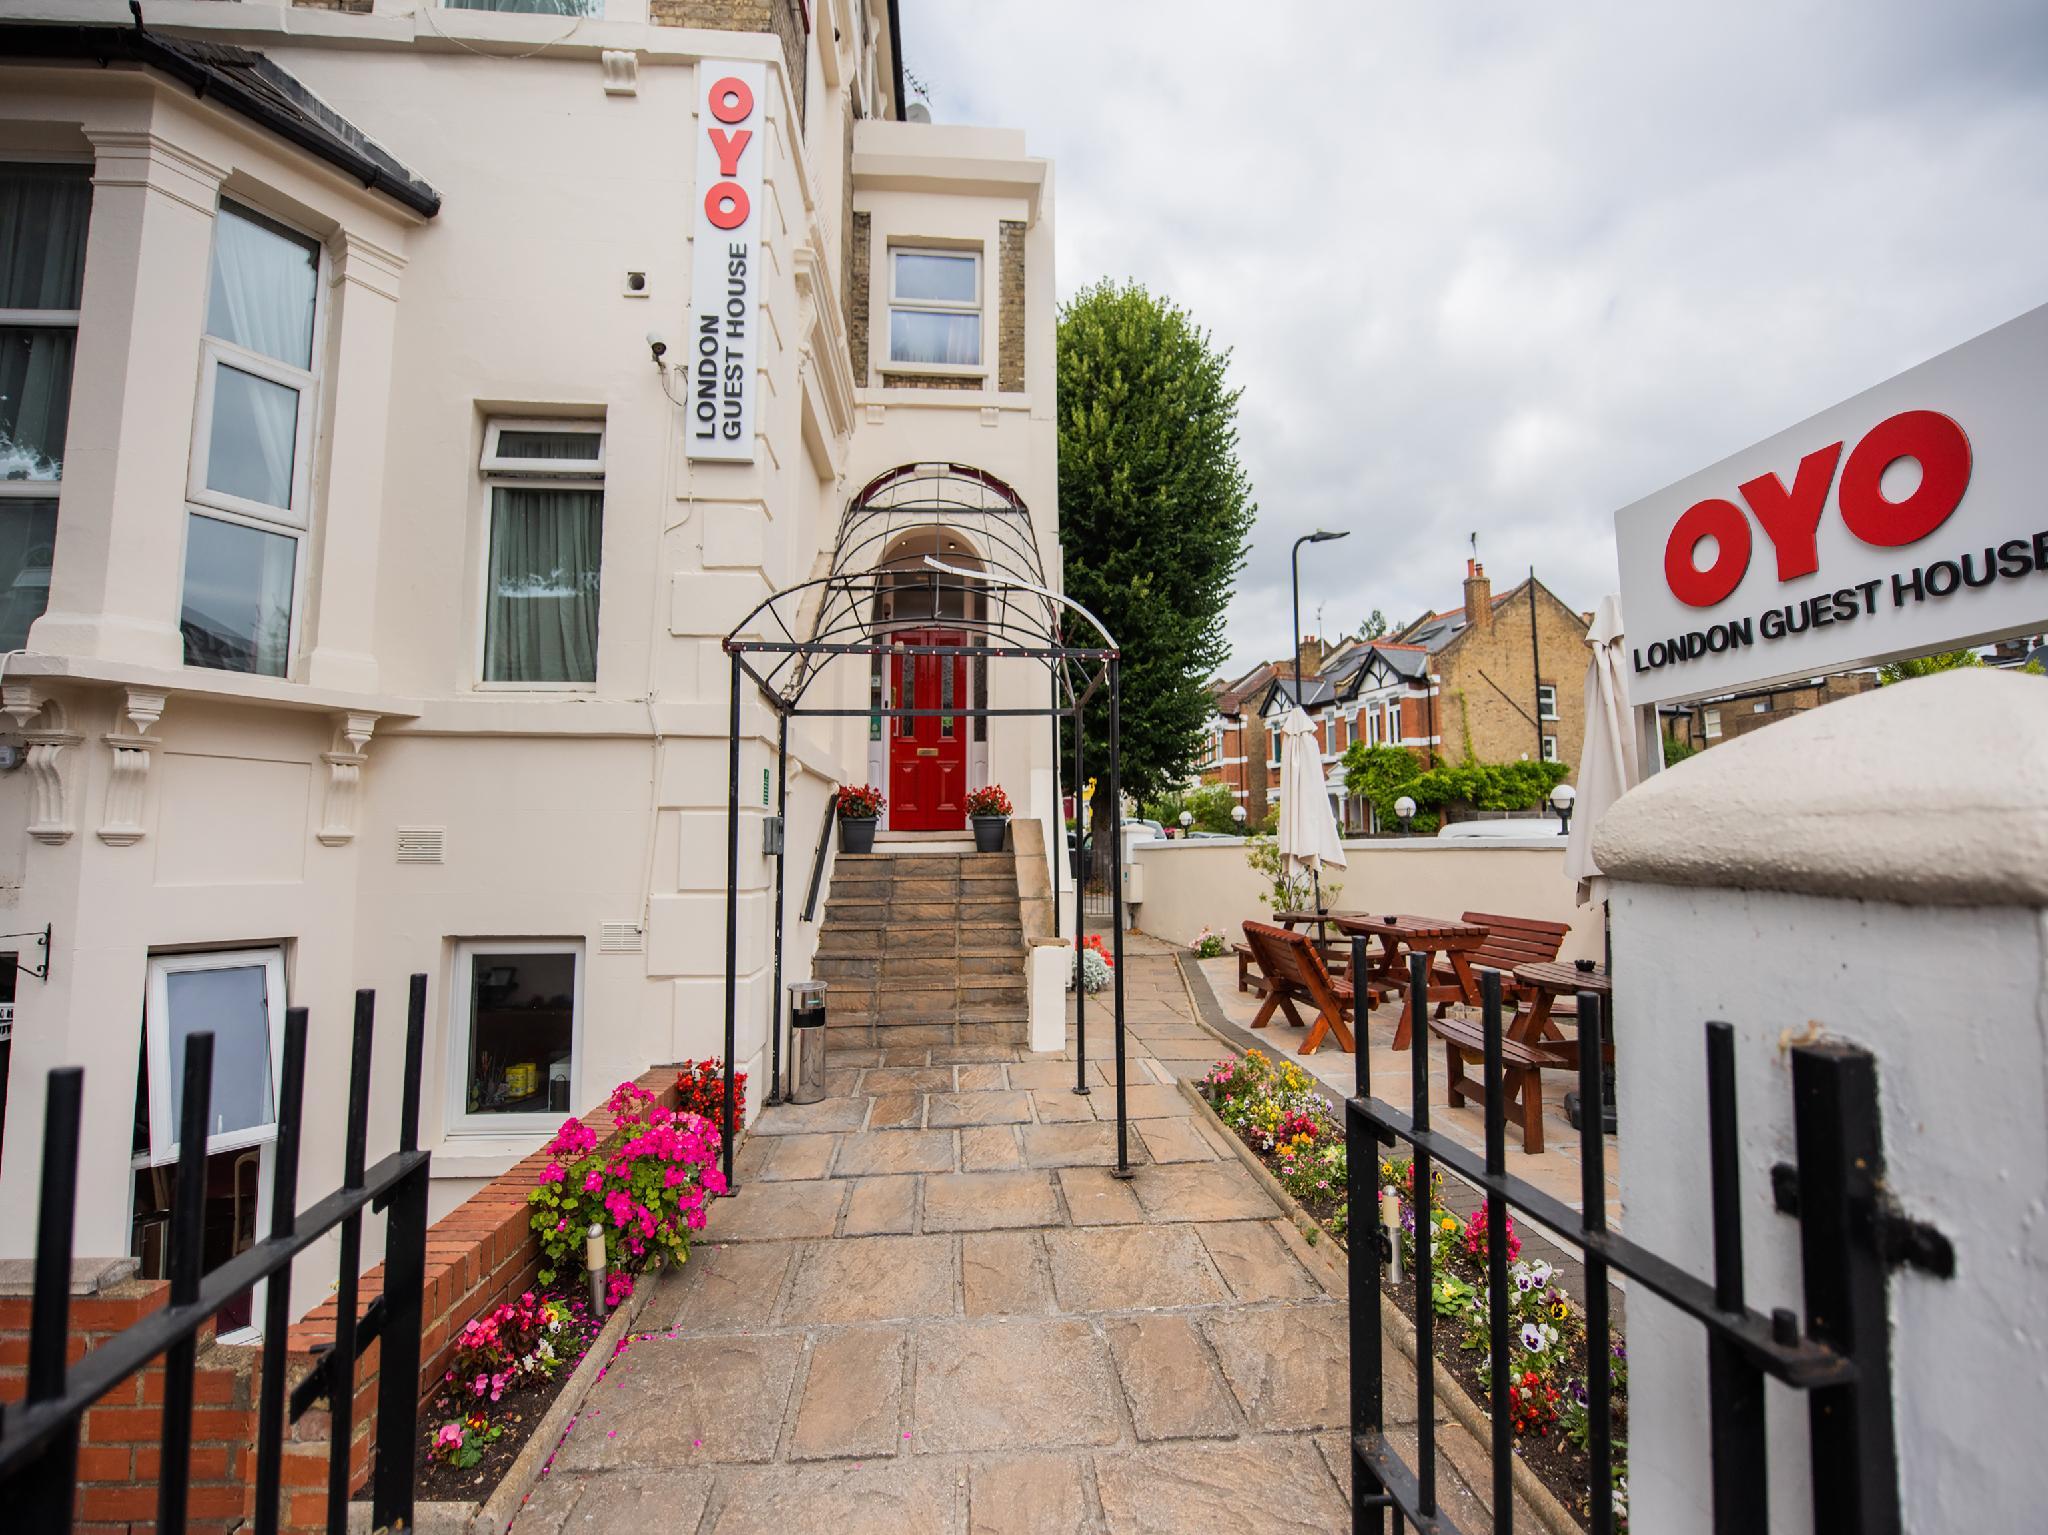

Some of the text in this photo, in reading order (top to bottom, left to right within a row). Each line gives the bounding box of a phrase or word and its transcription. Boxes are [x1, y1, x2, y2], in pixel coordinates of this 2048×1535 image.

[704, 78, 753, 230] OYO
[696, 315, 720, 440] LONDON
[723, 242, 747, 441] GUEST HOUSE
[1664, 409, 1972, 608] OYO
[1633, 617, 1754, 673] LONDON
[1759, 578, 1882, 640] GUEST
